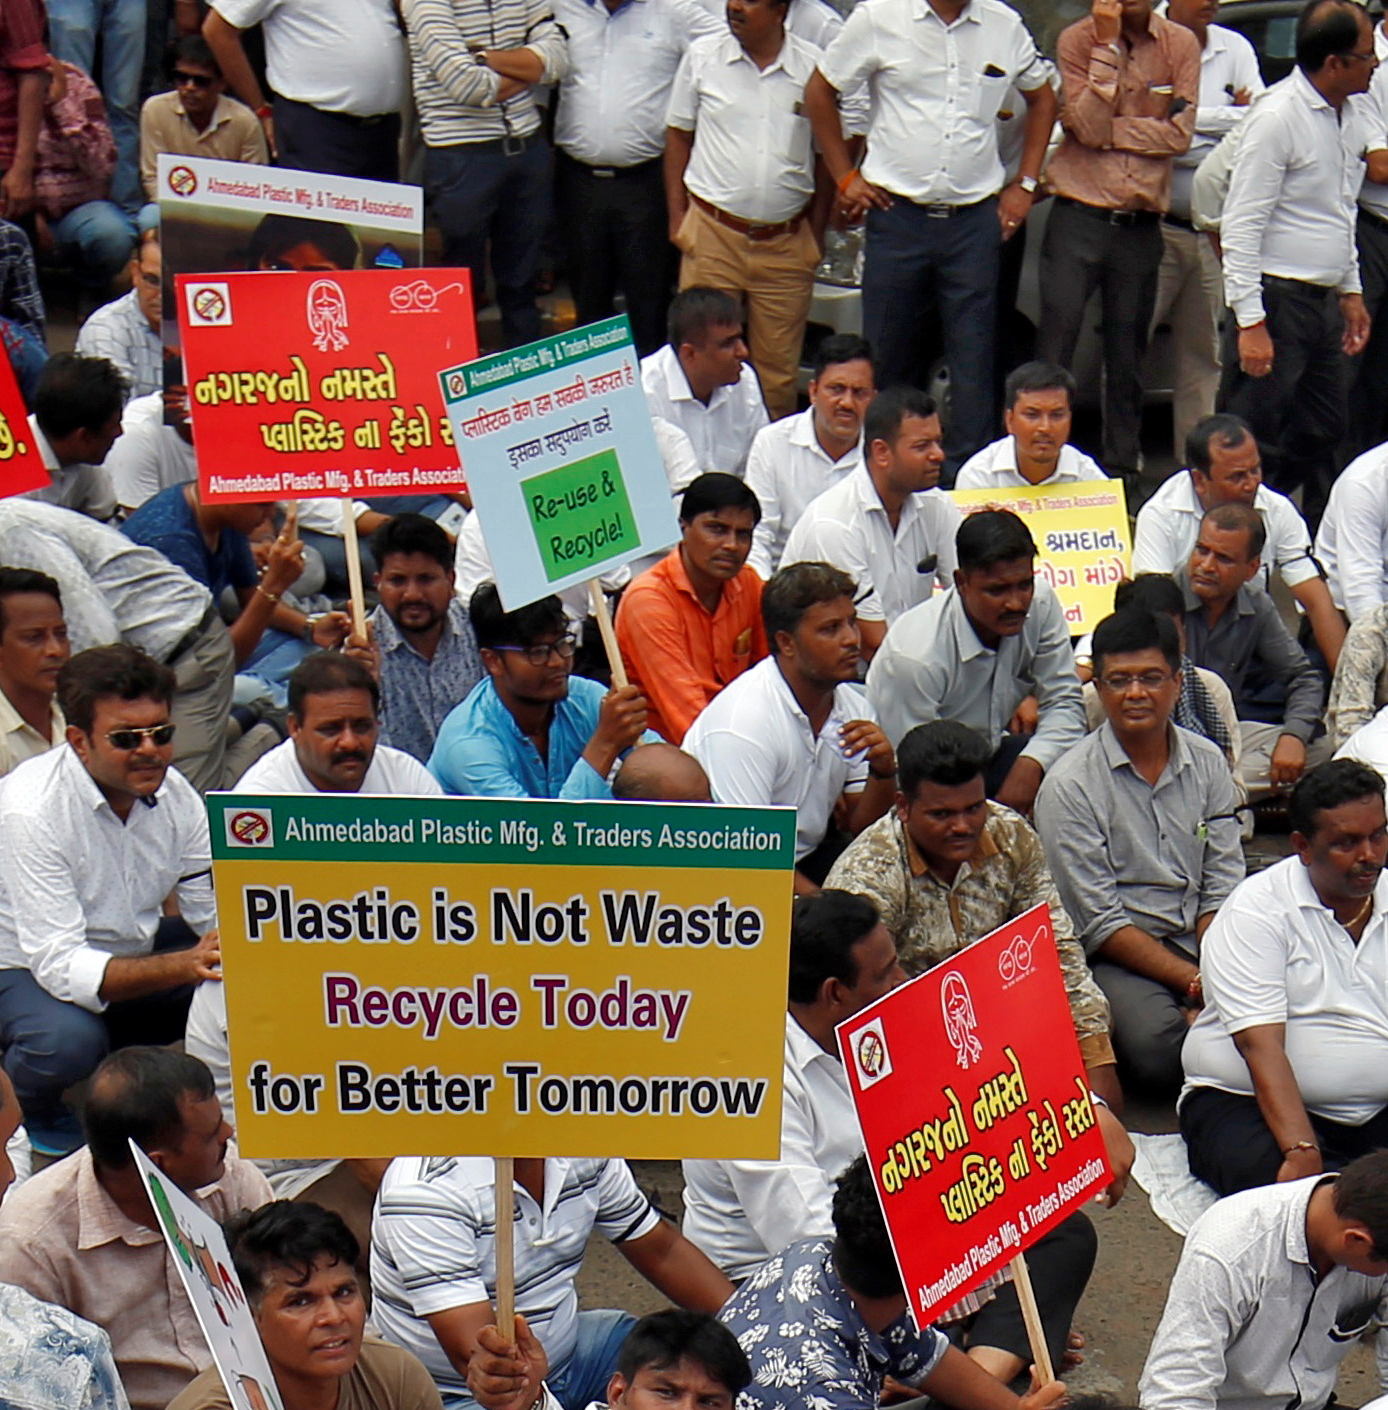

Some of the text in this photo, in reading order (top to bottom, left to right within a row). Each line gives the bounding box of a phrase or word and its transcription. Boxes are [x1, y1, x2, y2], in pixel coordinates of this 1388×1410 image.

[533, 470, 616, 521] Re-use &
[551, 512, 624, 563] Recycle!
[286, 817, 781, 851] Ahmedabad Plastic Mfg. & Traders Association
[247, 890, 763, 947] Plastic is Not Waste
[323, 972, 692, 1042] Recycle Today
[248, 1062, 768, 1117] for Better Tomorrow
